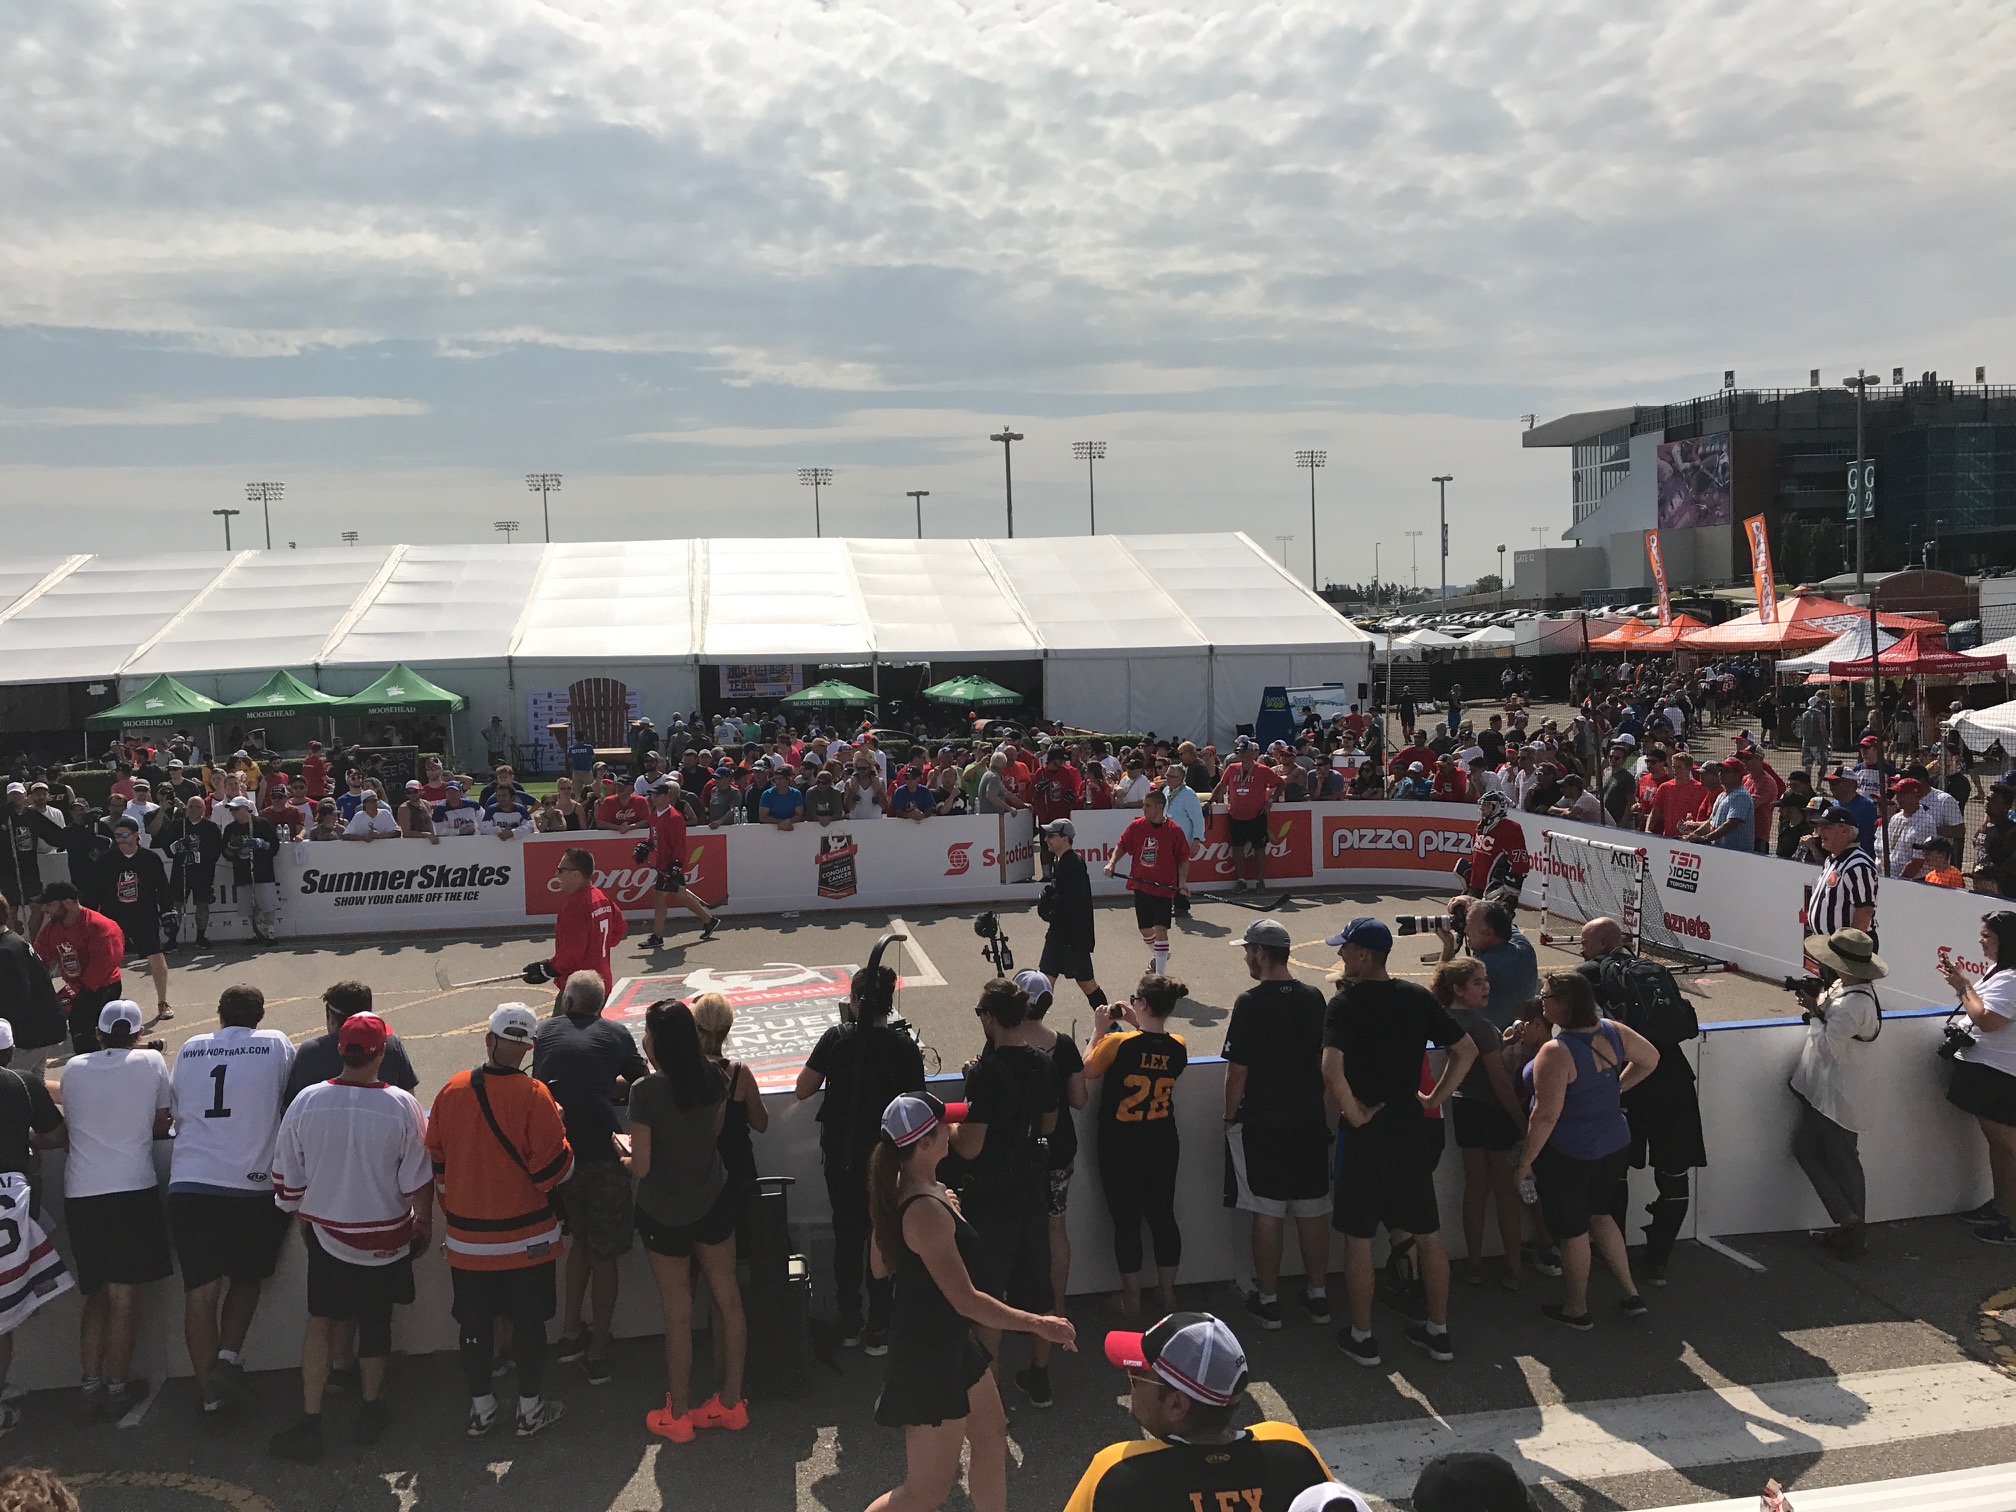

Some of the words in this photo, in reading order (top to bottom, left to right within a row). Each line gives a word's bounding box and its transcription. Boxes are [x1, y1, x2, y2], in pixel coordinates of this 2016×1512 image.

[1515, 553, 1529, 563] GATE
[368, 706, 417, 714] MOOSEHEAD
[792, 699, 831, 707] MOOSEHEAD
[246, 709, 296, 719] MOOSEHEAD
[122, 718, 174, 728] MOOSEHEAD
[1332, 828, 1415, 858] pizza
[1418, 829, 1473, 860] pizz
[1669, 850, 1703, 870] TSN
[300, 863, 512, 895] SummerSkates
[821, 865, 852, 879] CONQUER
[827, 870, 852, 883] CANCER
[1672, 866, 1700, 882] 1050
[1669, 879, 1696, 891] TORONTO
[333, 895, 367, 907] SHOW
[367, 893, 394, 906] YOUR
[394, 891, 424, 904] GAME
[424, 891, 444, 903] OFF
[444, 891, 464, 902] THE
[462, 890, 480, 901] ICE
[599, 918, 610, 958] 7
[182, 1046, 271, 1059] WWW.NORTRAX.COM
[1139, 1052, 1171, 1071] LEX
[203, 1064, 232, 1119] 1
[1116, 1073, 1177, 1122] 28
